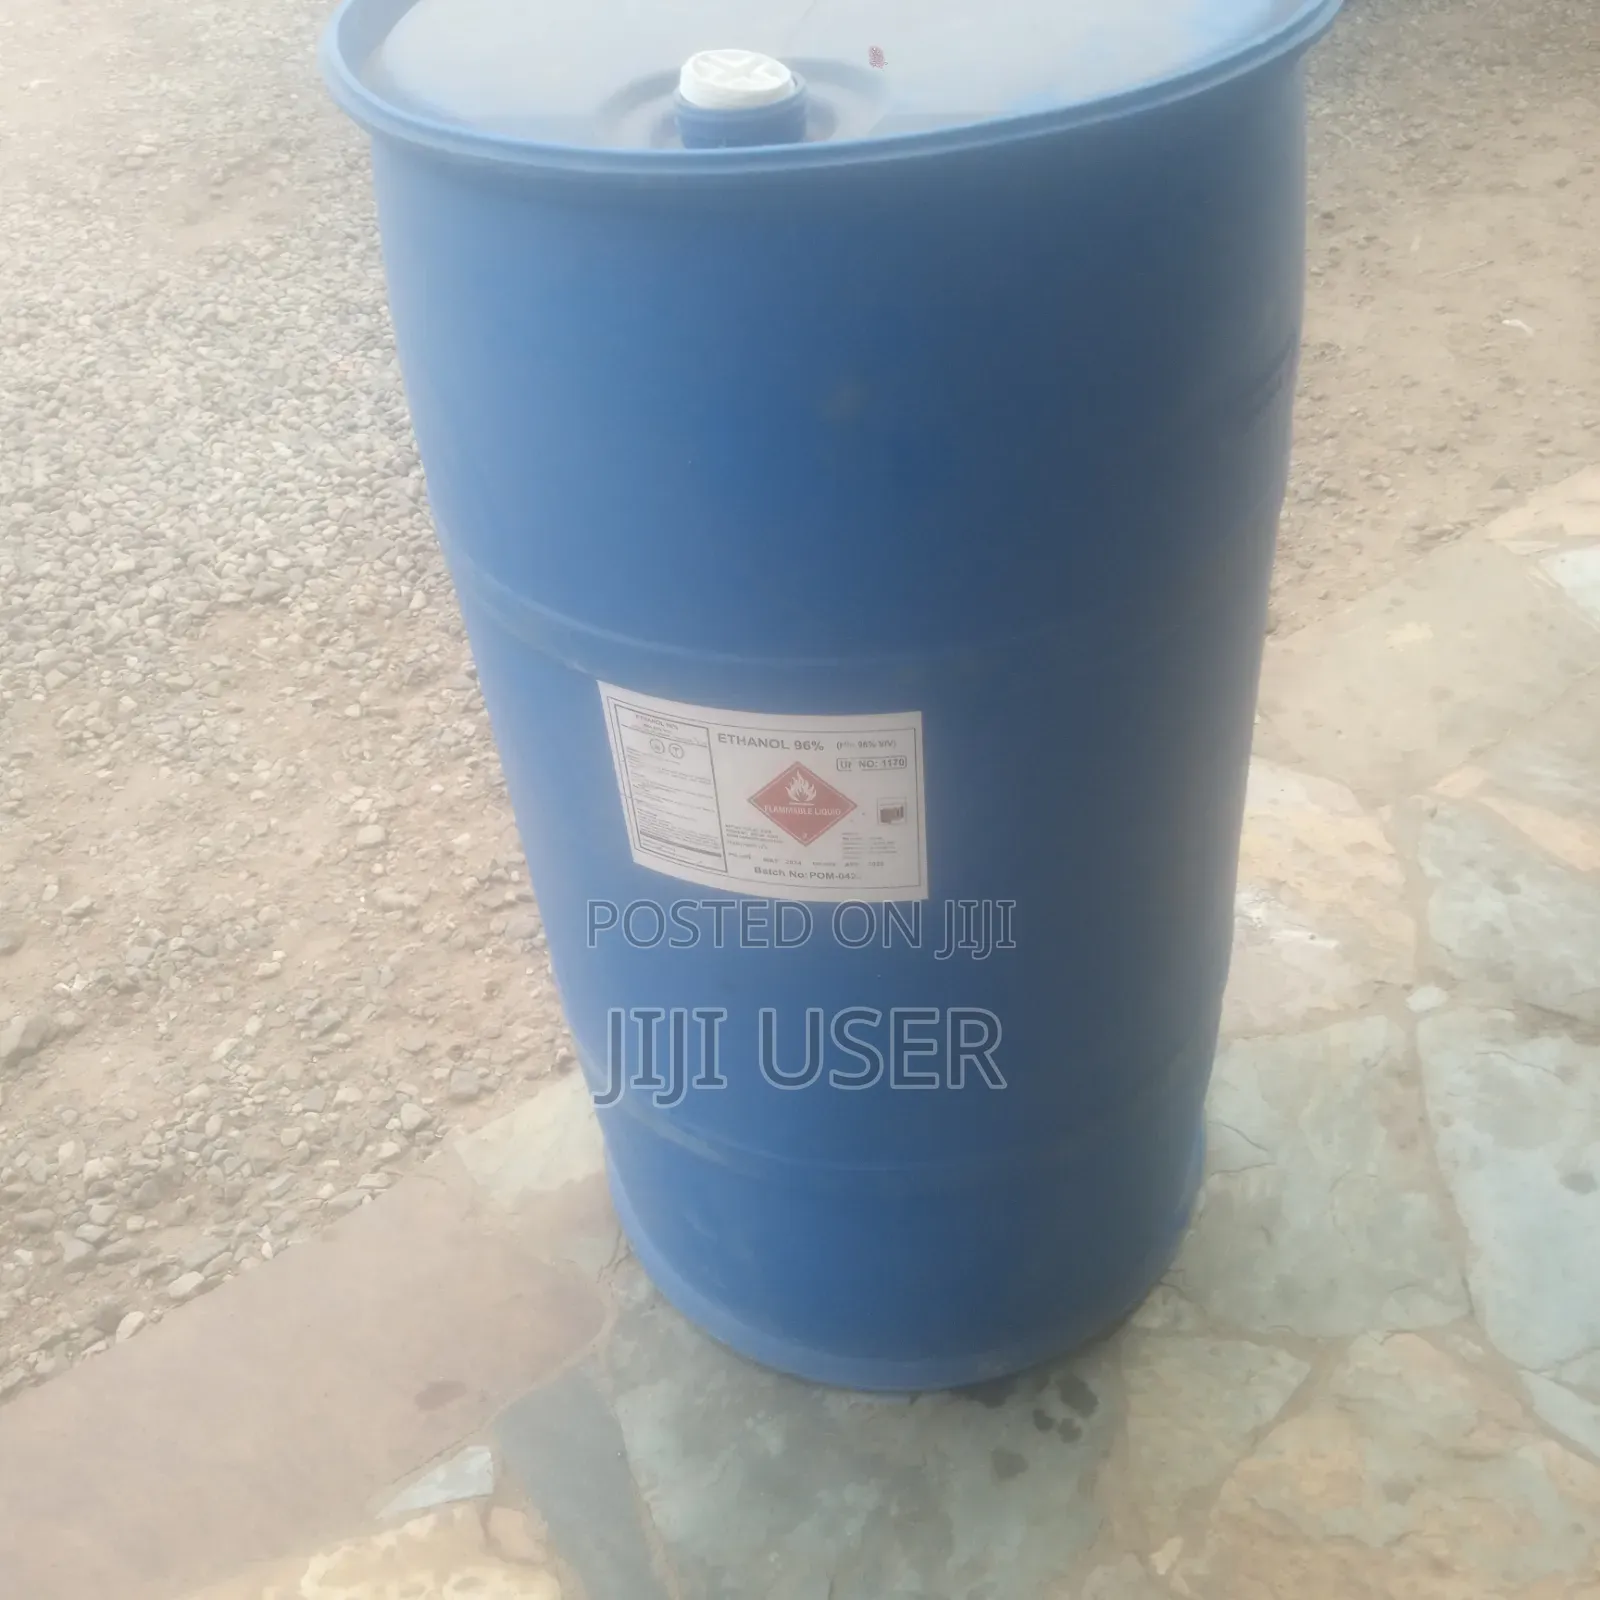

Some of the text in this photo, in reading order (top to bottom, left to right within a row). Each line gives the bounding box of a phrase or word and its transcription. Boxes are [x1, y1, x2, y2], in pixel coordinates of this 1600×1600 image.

[717, 733, 790, 750] ETHANOL
[794, 739, 825, 751] 96%
[859, 758, 879, 769] NO:
[882, 757, 905, 768] 1170
[764, 804, 842, 816] FLAMMABLE LIQUID
[754, 866, 861, 881] Batch No: POM-042
